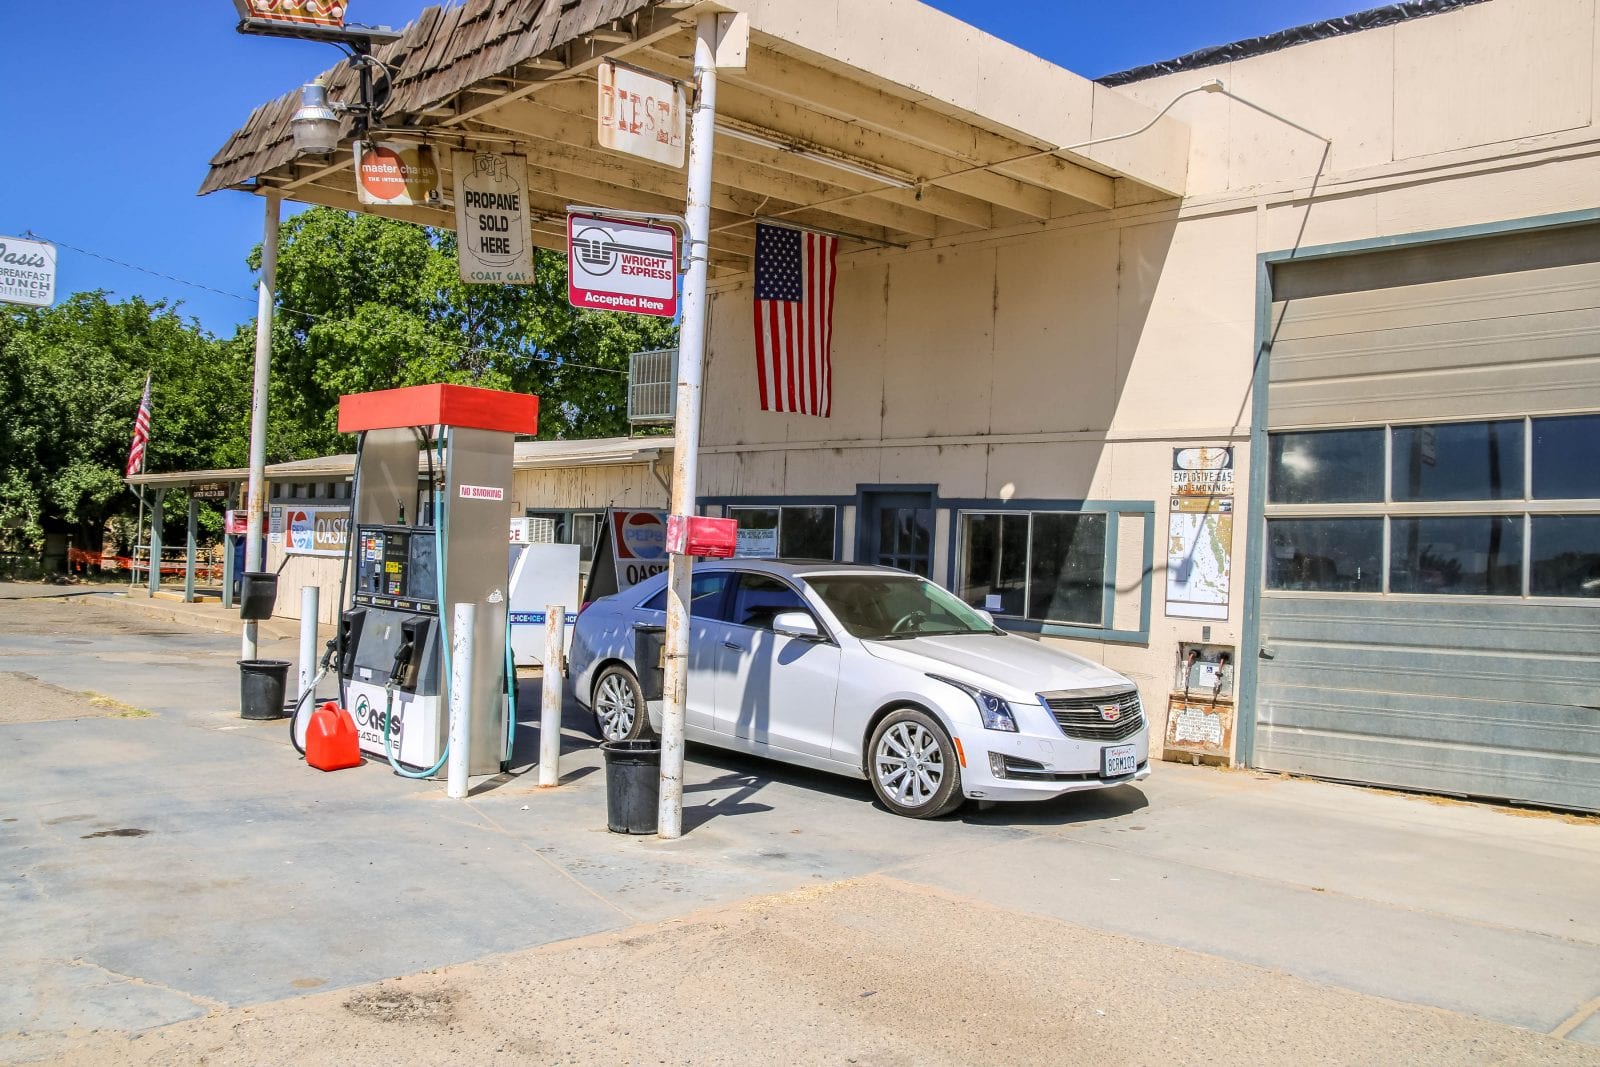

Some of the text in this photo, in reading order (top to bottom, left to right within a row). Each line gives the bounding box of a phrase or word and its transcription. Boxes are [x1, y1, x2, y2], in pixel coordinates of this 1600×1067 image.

[362, 164, 397, 174] master
[466, 191, 520, 211] PROPANE
[479, 214, 509, 232] SOLD
[480, 236, 510, 254] HERE
[621, 254, 667, 269] WRIGHT
[470, 271, 527, 280] COAST GAS
[621, 265, 672, 280] EXPRESS
[585, 292, 664, 310] Accepted Here
[1174, 472, 1232, 482] EXPLOSIVE GAS
[461, 487, 502, 498] NO SMOKING
[1191, 484, 1226, 492] SMOKING
[509, 530, 520, 541] CE
[625, 528, 666, 541] PEPS
[627, 565, 668, 585] OAS
[355, 694, 400, 735] Oass
